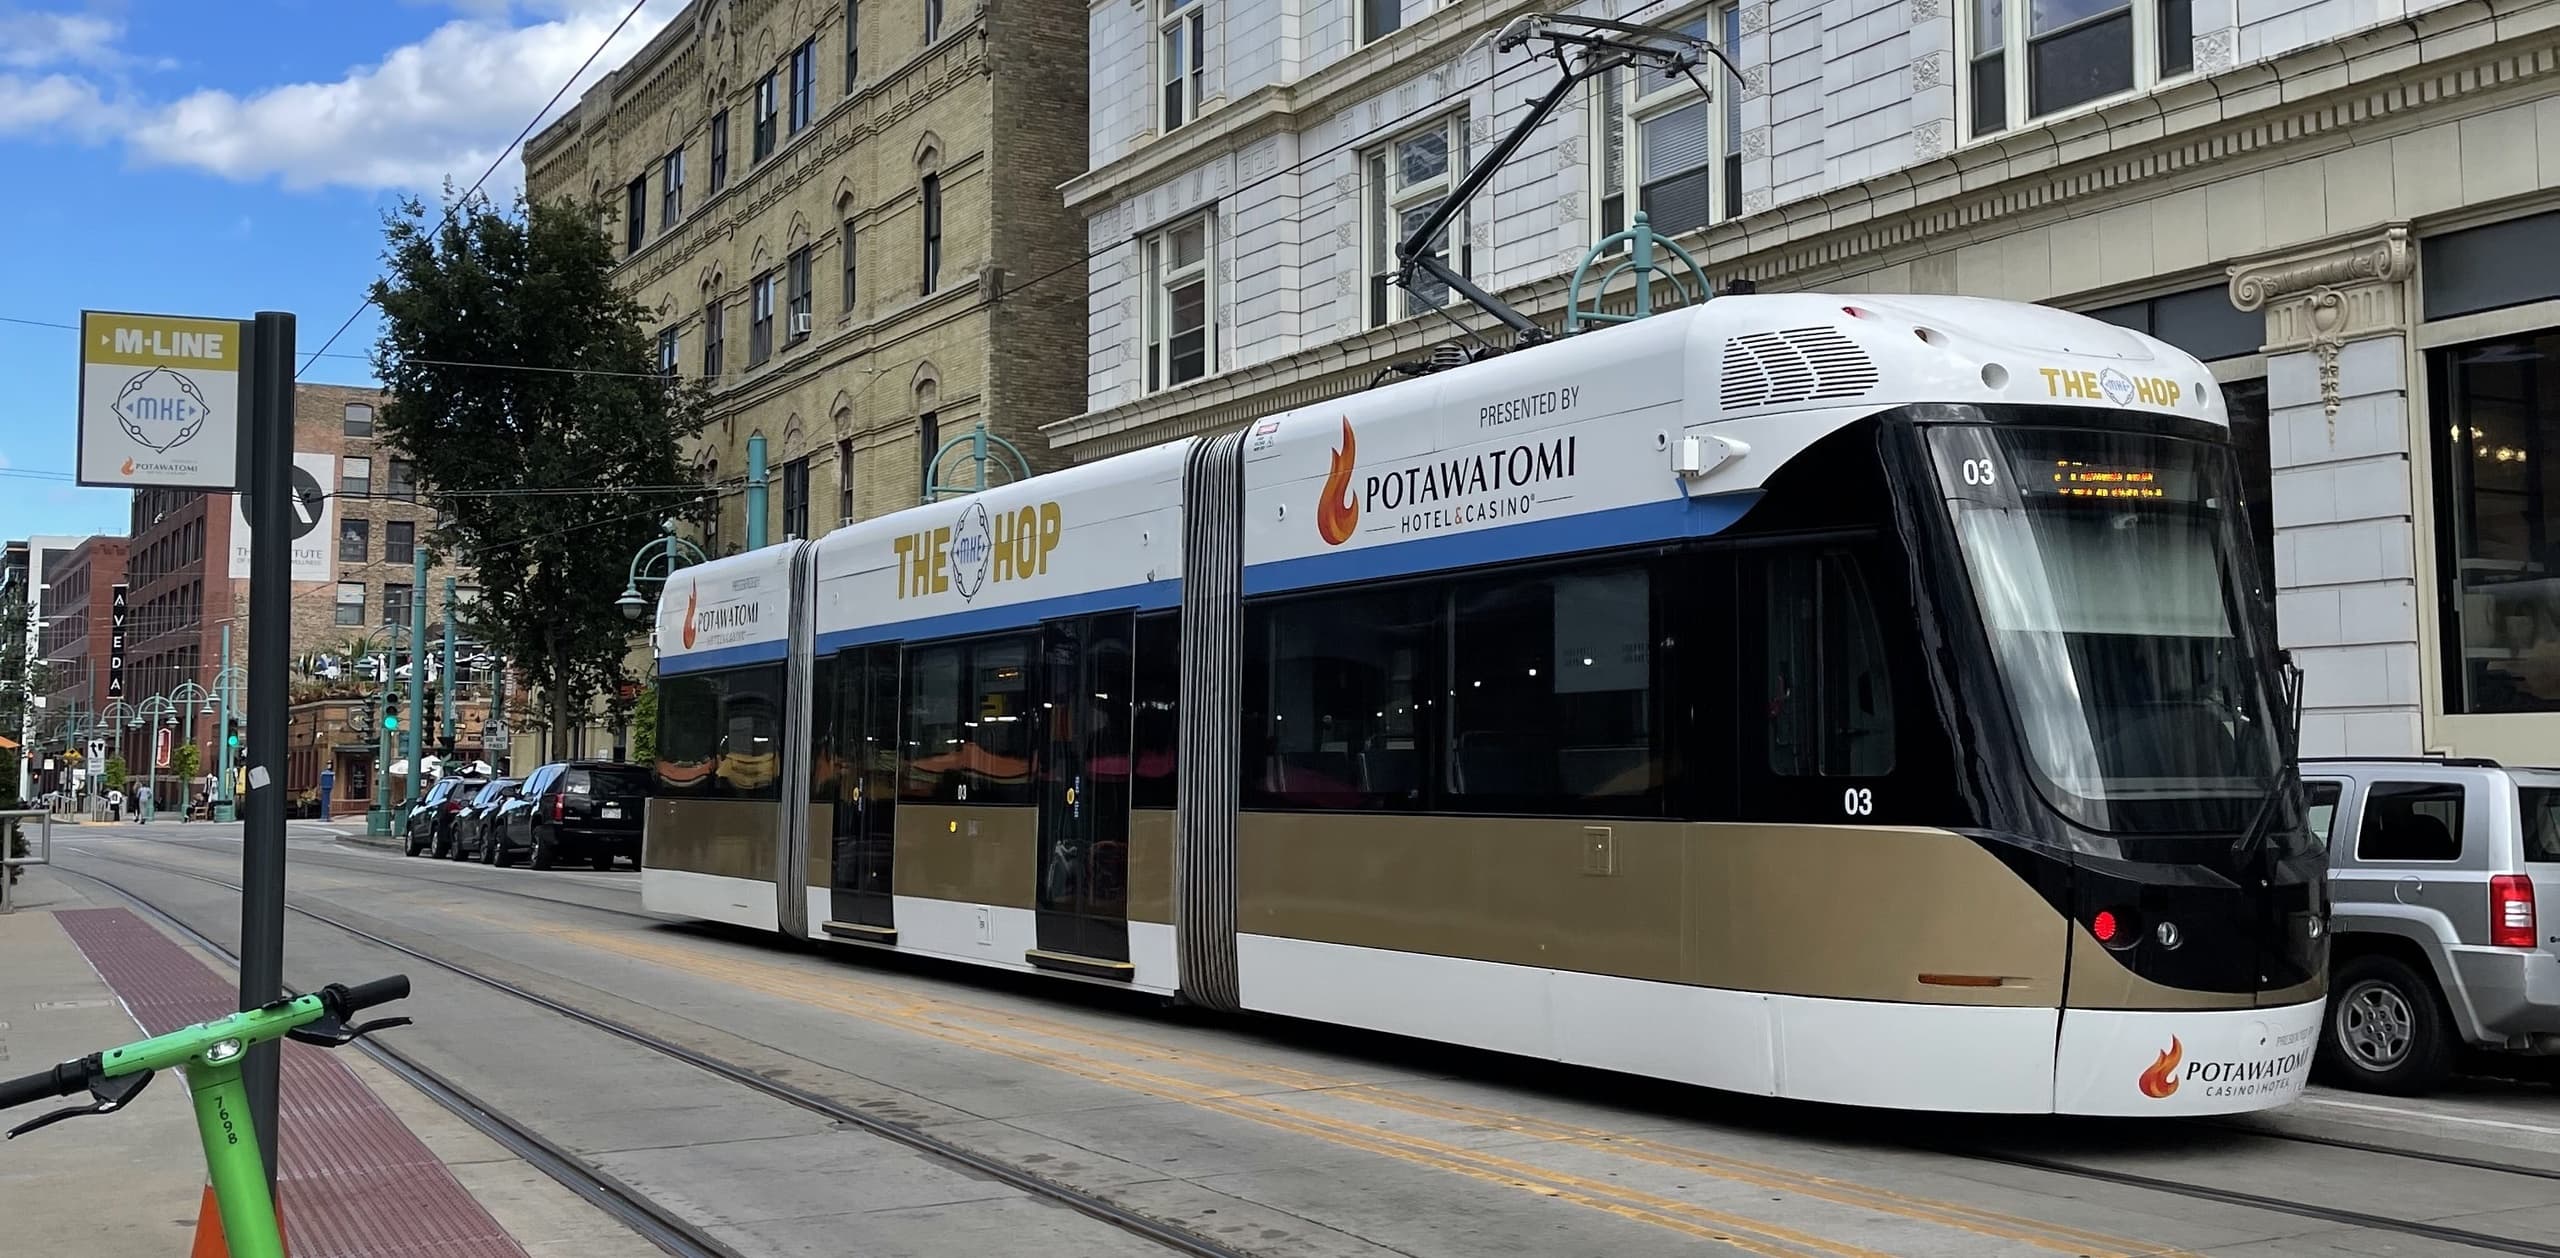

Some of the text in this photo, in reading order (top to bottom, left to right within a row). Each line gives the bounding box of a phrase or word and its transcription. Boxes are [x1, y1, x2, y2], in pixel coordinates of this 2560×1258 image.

[1480, 385, 1579, 428] PRESENTED BY
[2039, 368, 2102, 399] THE
[2133, 376, 2180, 407] HOP
[135, 463, 198, 473] POTAWATOMI
[1366, 436, 1575, 513] POTAWATOMI
[1963, 459, 1995, 486] 03
[894, 526, 950, 600] THE
[993, 501, 1062, 583] HOP
[698, 601, 759, 632] POTAWATOMI
[110, 594, 125, 691] AVEDA
[1845, 789, 1873, 816] 03
[2186, 1047, 2309, 1082] POTAWATOMI
[214, 1095, 239, 1145] 7698
